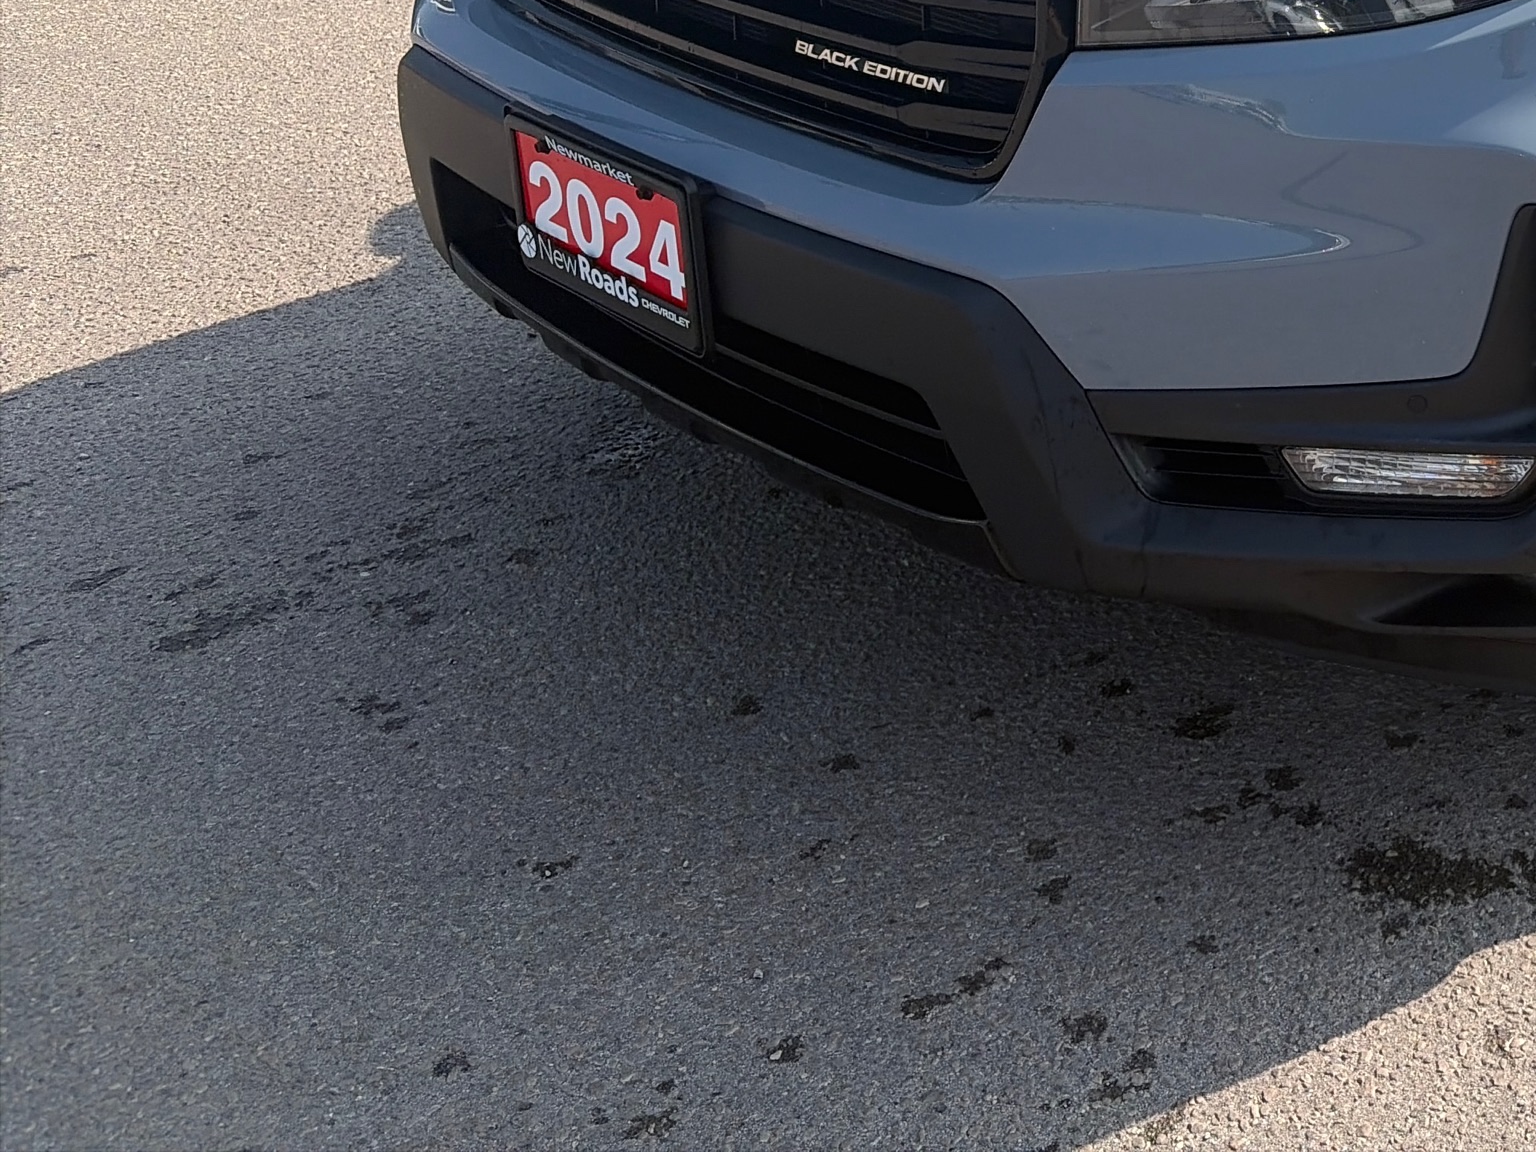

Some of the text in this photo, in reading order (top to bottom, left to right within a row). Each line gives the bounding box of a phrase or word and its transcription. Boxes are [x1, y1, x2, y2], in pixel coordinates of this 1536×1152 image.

[795, 39, 946, 93] BLACK EDITION
[544, 135, 635, 186] Newmarket
[528, 160, 686, 301] 2024
[537, 234, 691, 329] NewRoads CHEVROLET
